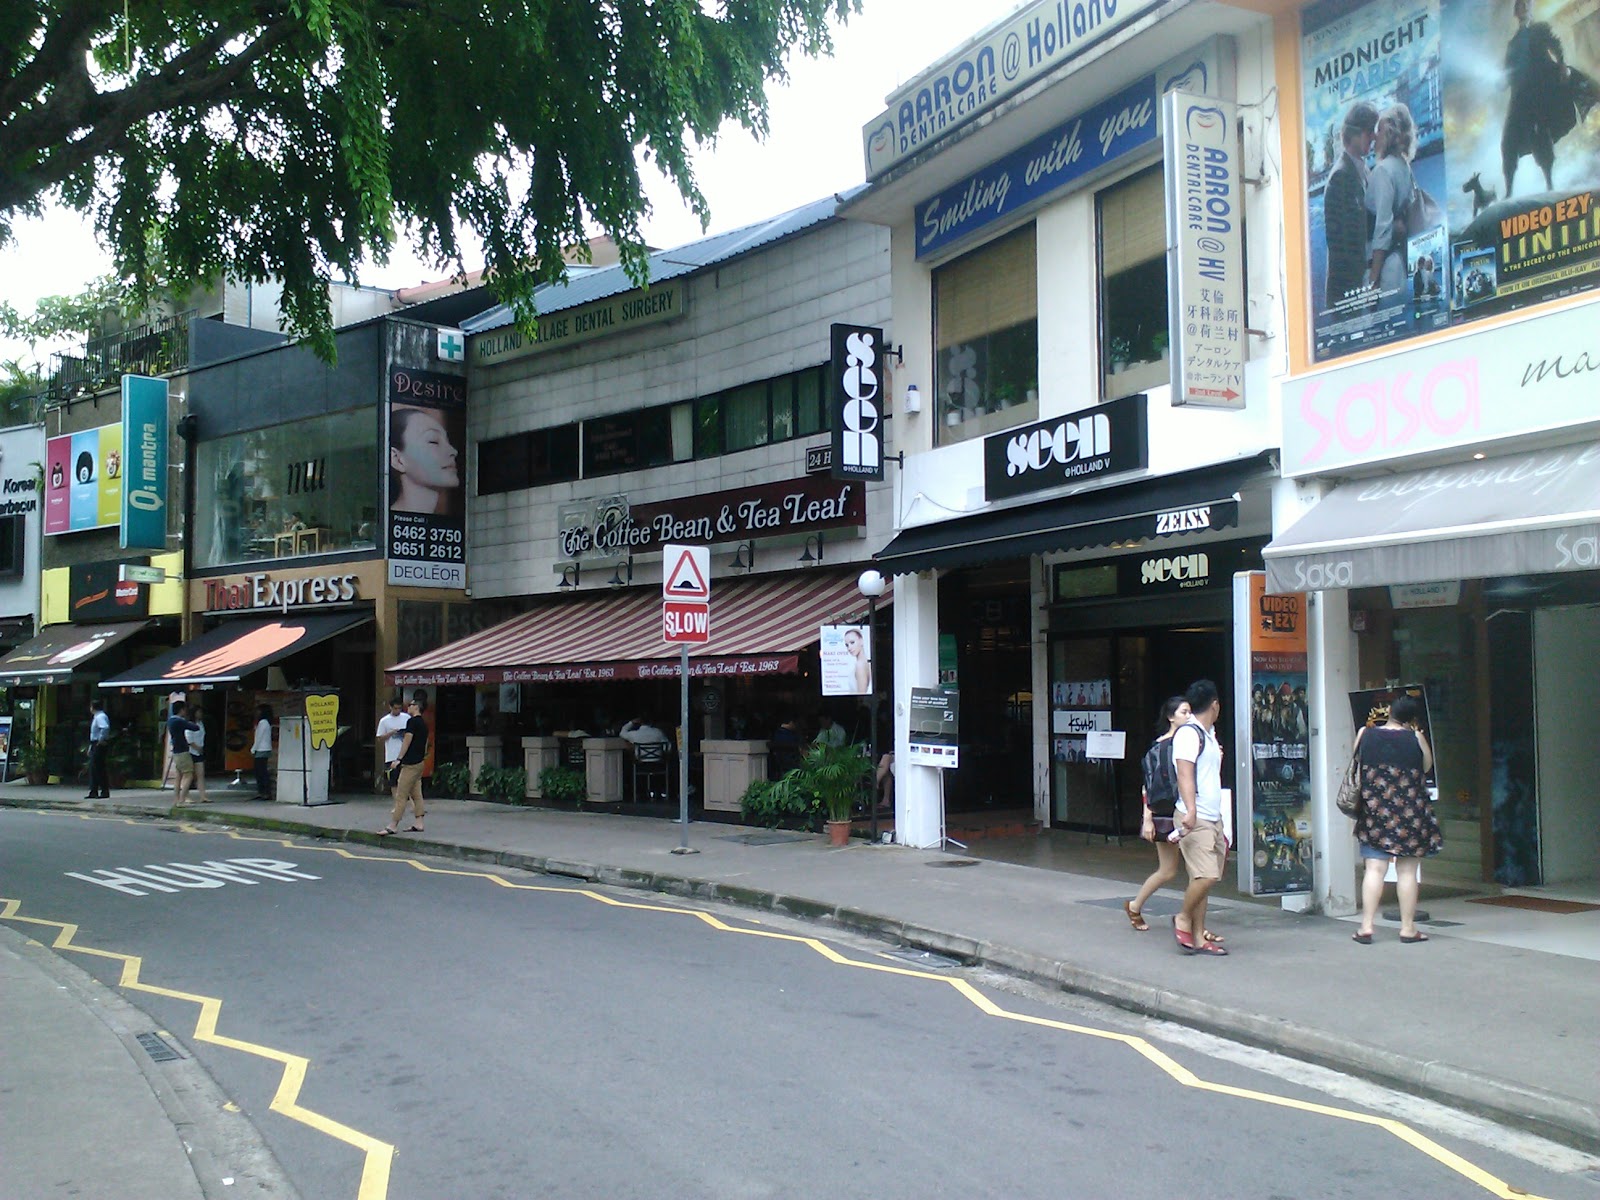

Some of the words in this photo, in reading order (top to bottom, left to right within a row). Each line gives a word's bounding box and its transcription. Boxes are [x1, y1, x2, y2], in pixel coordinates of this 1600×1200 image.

[1314, 13, 1429, 88] MIDNIGHT
[899, 45, 996, 134] AARON
[1001, 32, 1021, 81] @
[1329, 81, 1339, 94] IN
[1339, 53, 1401, 100] PARIS
[921, 172, 1012, 247] Smiling
[1025, 119, 1083, 187] with
[1099, 98, 1153, 156] you
[1500, 205, 1553, 239] VIDEO
[1555, 192, 1591, 223] EZY
[1197, 236, 1225, 254] @
[1198, 257, 1225, 282] HV
[1523, 257, 1545, 268] SECRET
[479, 334, 522, 358] HOLLAND
[575, 306, 615, 334] DENTAL
[622, 289, 674, 321] SURGERY
[394, 371, 465, 401] Desire
[809, 453, 821, 467] 24
[560, 527, 589, 556] The
[593, 518, 651, 549] Coffee
[653, 514, 714, 541] Bean
[716, 505, 736, 533] &
[738, 499, 781, 530] Tea
[783, 485, 851, 524] Leaf
[1156, 506, 1211, 534] ZEISS
[393, 524, 427, 540] 6462
[429, 528, 462, 543] 3750
[392, 541, 425, 557] 9651
[429, 544, 462, 559] 2612
[1262, 596, 1298, 612] VIDEO
[665, 611, 707, 634] SLOW
[1275, 612, 1297, 628] EZY
[598, 667, 615, 678] 1963
[651, 664, 673, 676] Coffee
[696, 664, 702, 674] &
[702, 663, 717, 674] Tea
[716, 662, 739, 674] Leaf
[740, 661, 757, 673] Est.
[758, 660, 780, 671] 1963
[63, 858, 323, 896] HUMP
